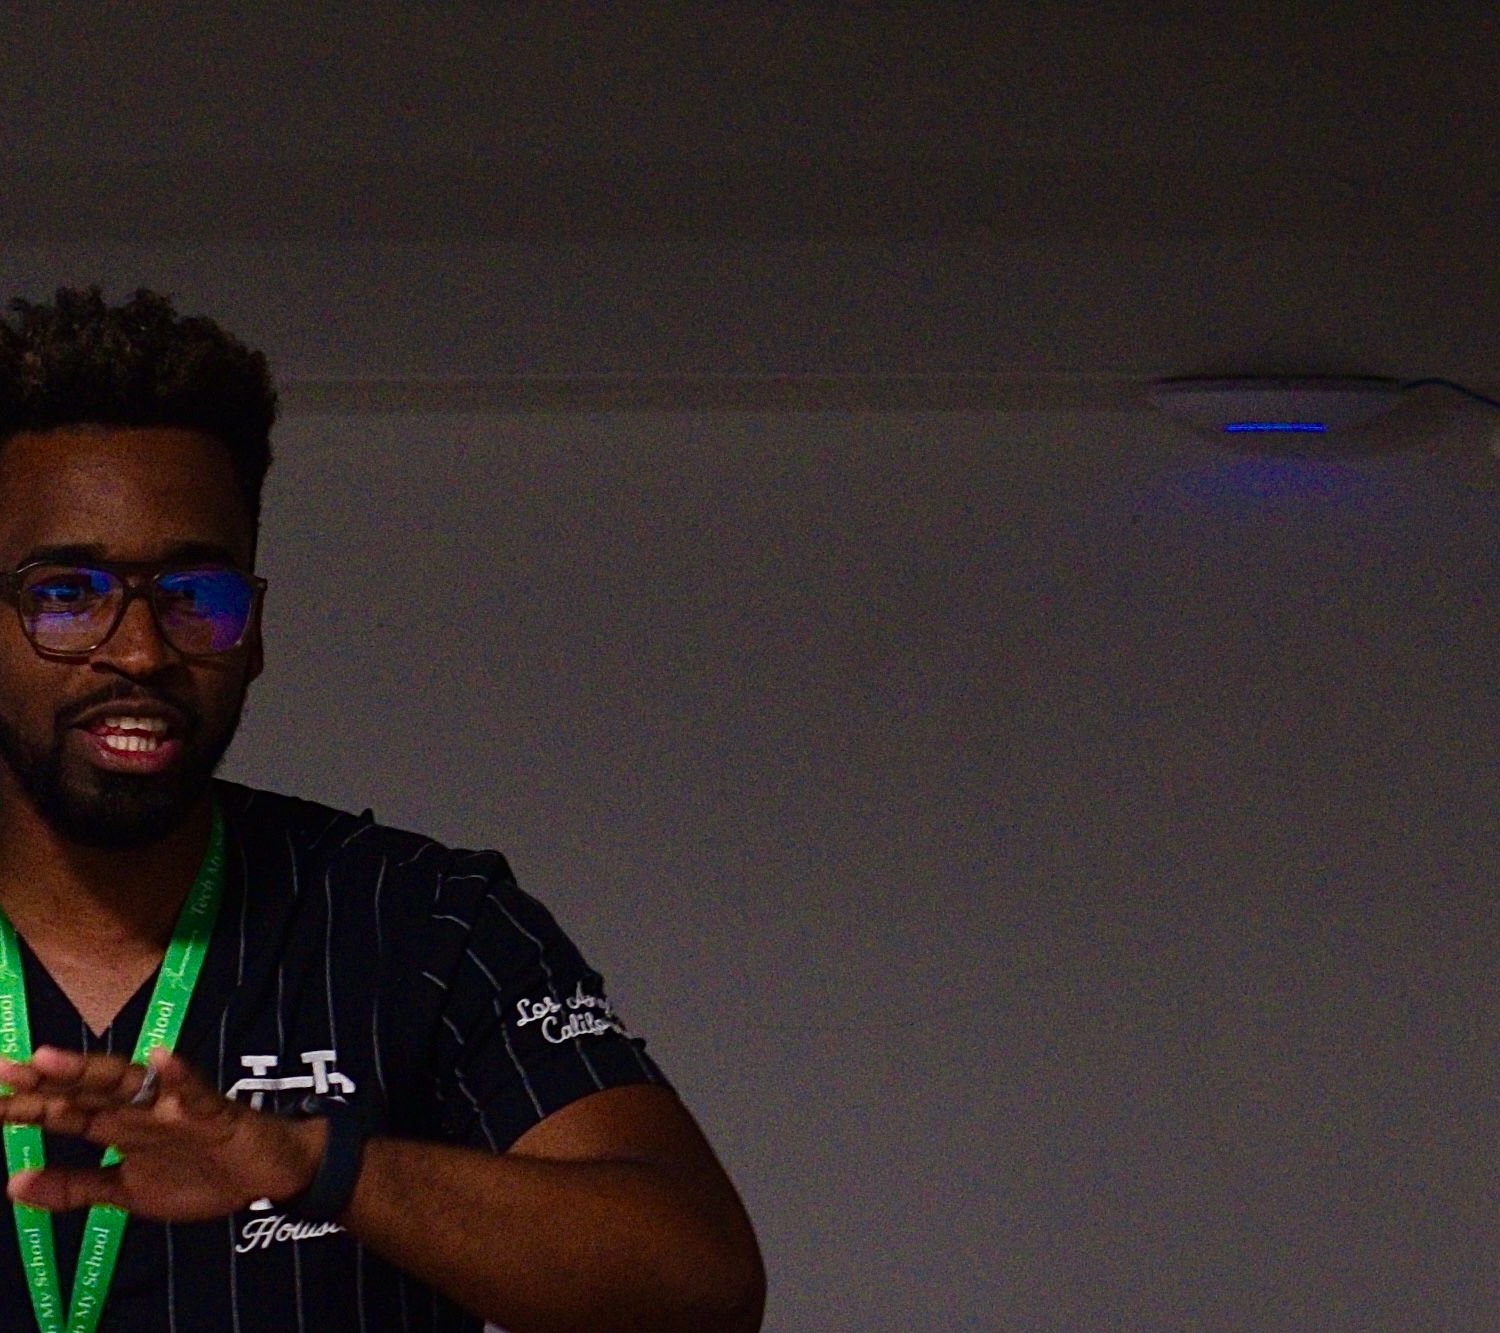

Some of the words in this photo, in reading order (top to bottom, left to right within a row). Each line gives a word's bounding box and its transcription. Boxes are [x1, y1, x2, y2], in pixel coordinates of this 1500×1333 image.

[517, 997, 561, 1027] Los
[24, 1228, 48, 1286] School
[83, 1227, 110, 1287] School
[41, 1293, 54, 1317] My
[76, 1294, 96, 1318] My
